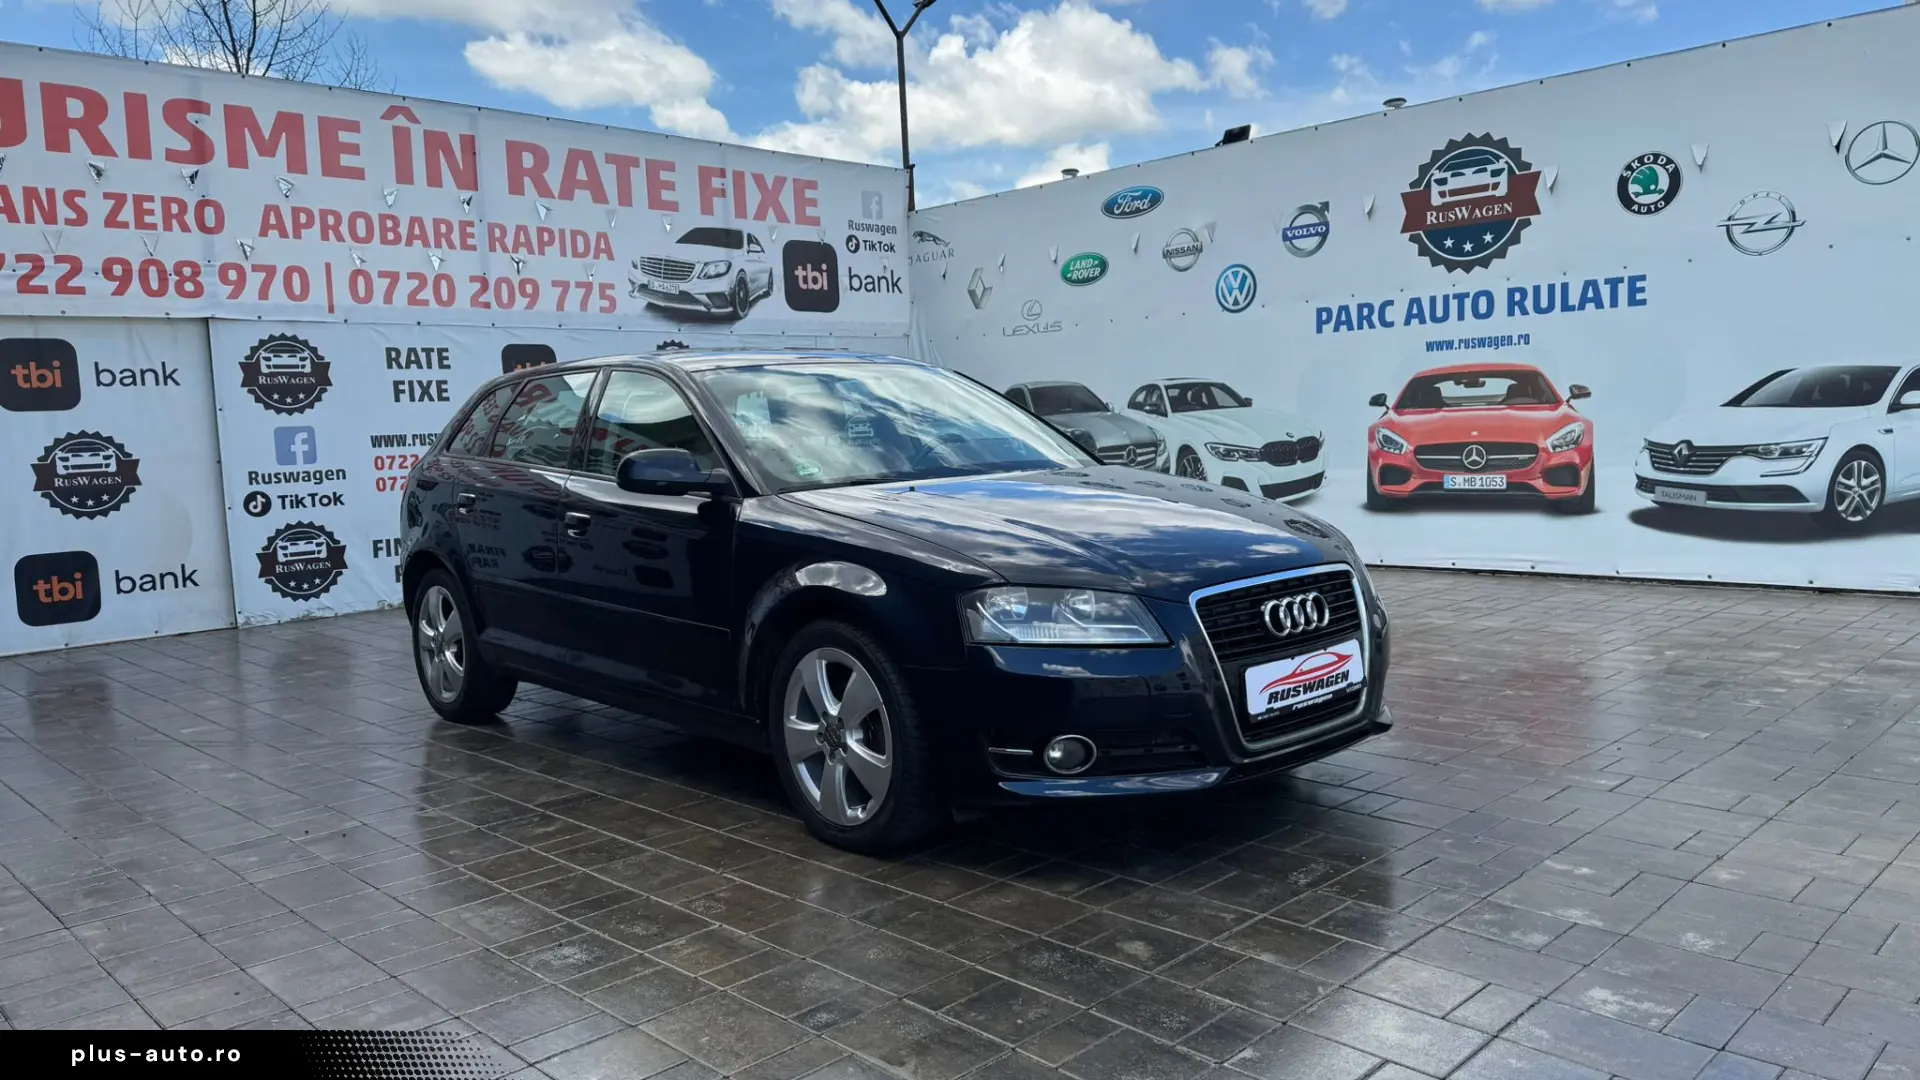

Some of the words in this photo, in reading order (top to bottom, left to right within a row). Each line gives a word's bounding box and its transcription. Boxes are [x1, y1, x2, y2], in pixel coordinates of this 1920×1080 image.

[380, 104, 478, 191] ÎN
[506, 139, 680, 213] RATE
[698, 165, 821, 227] FIXE
[1622, 154, 1676, 179] SKODA
[1113, 190, 1153, 215] Ford
[1631, 200, 1665, 213] AUTO
[102, 191, 225, 235] ZERO
[259, 204, 476, 252] APROBARE
[488, 222, 614, 261] RAPIDA
[847, 220, 897, 236] Ruswagen
[1285, 223, 1327, 238] VOLVO
[862, 239, 896, 254] TikTok
[907, 247, 955, 267] JAGUAR
[1165, 244, 1200, 256] NISSAN
[1069, 258, 1094, 271] LAND
[1071, 267, 1101, 281] ROVER
[0, 252, 87, 295] 22
[101, 256, 205, 299] 908
[218, 262, 310, 302] 970
[348, 269, 456, 309] 0720
[470, 275, 540, 311] 209
[552, 281, 616, 314] 775
[794, 263, 829, 291] tbi
[848, 265, 903, 294] bank
[1315, 300, 1395, 334] PARC
[1403, 289, 1496, 327] AUTO
[1506, 274, 1648, 318] RULATE
[1002, 321, 1063, 338] LEXUS
[1425, 333, 1531, 353] www.ruswagen.ro
[384, 347, 452, 370] RATE
[10, 361, 63, 389] tbi
[94, 361, 181, 388] bank
[392, 379, 450, 403] FIXE
[247, 466, 347, 487] Ruswagen
[279, 491, 345, 511] TikTok
[32, 572, 84, 603] tbi
[114, 564, 200, 595] bank
[1266, 669, 1350, 706] RUSWAGEN
